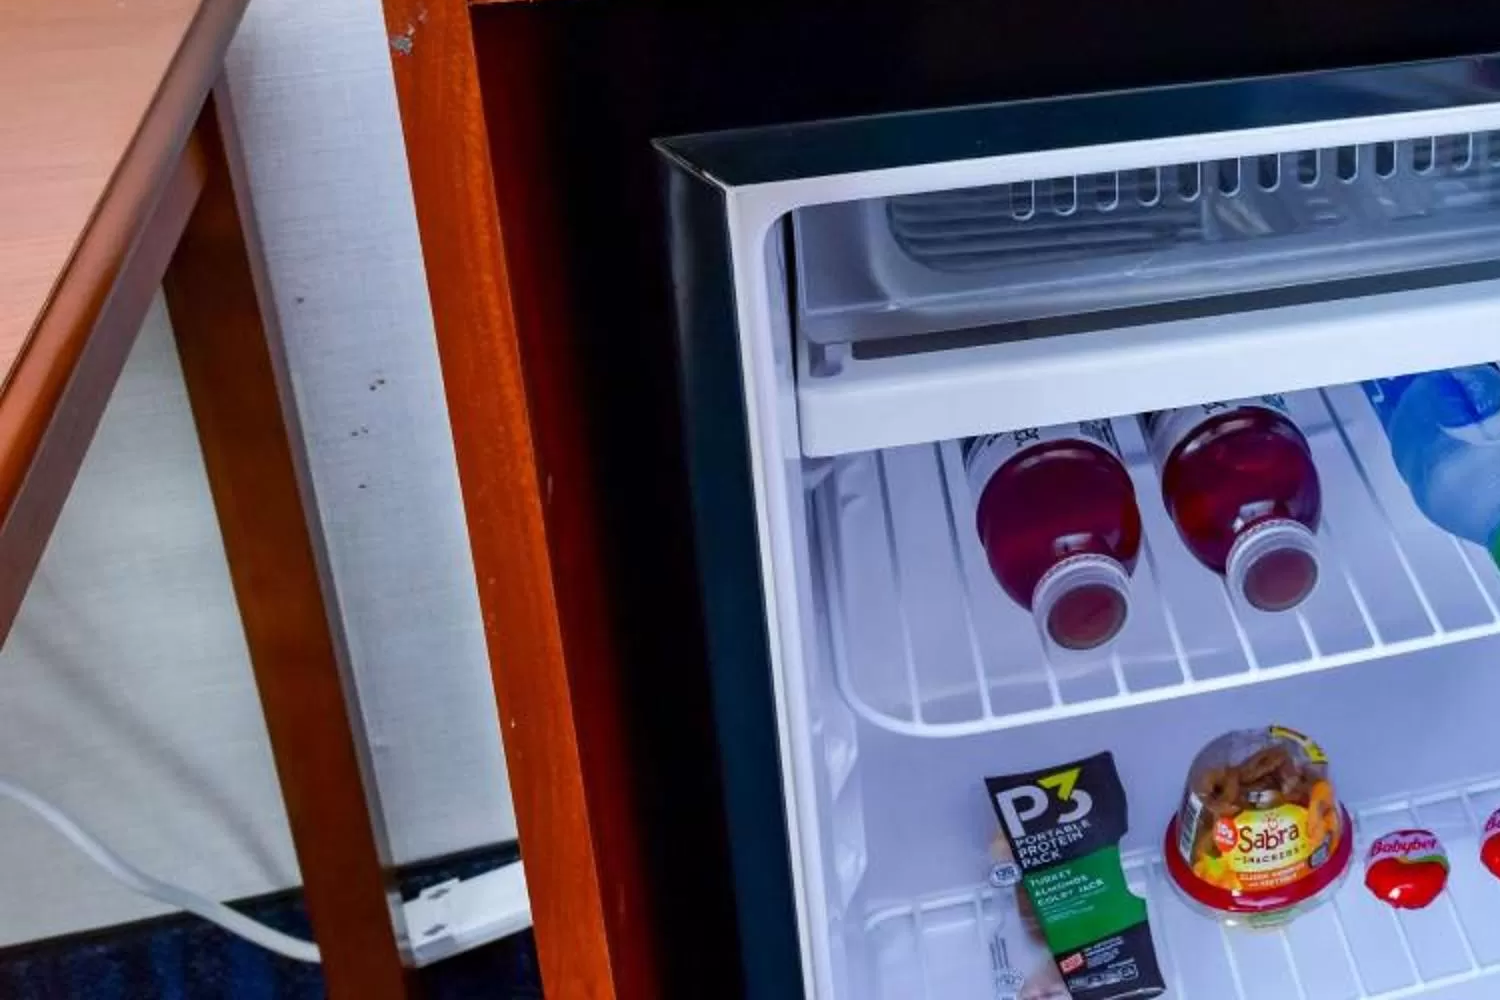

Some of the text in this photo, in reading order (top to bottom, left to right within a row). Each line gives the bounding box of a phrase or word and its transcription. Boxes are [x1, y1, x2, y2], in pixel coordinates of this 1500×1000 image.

[995, 767, 1094, 839] P3
[1014, 819, 1092, 848] PORTABLE
[1018, 830, 1084, 859] PROTEIN
[1238, 823, 1299, 853] Sabra
[1371, 836, 1437, 857] Babybel
[1021, 851, 1062, 869] PACK
[1029, 869, 1073, 888] TURKEY
[1034, 874, 1089, 898] ALMONDS
[1037, 878, 1105, 906] COLBY JACK
